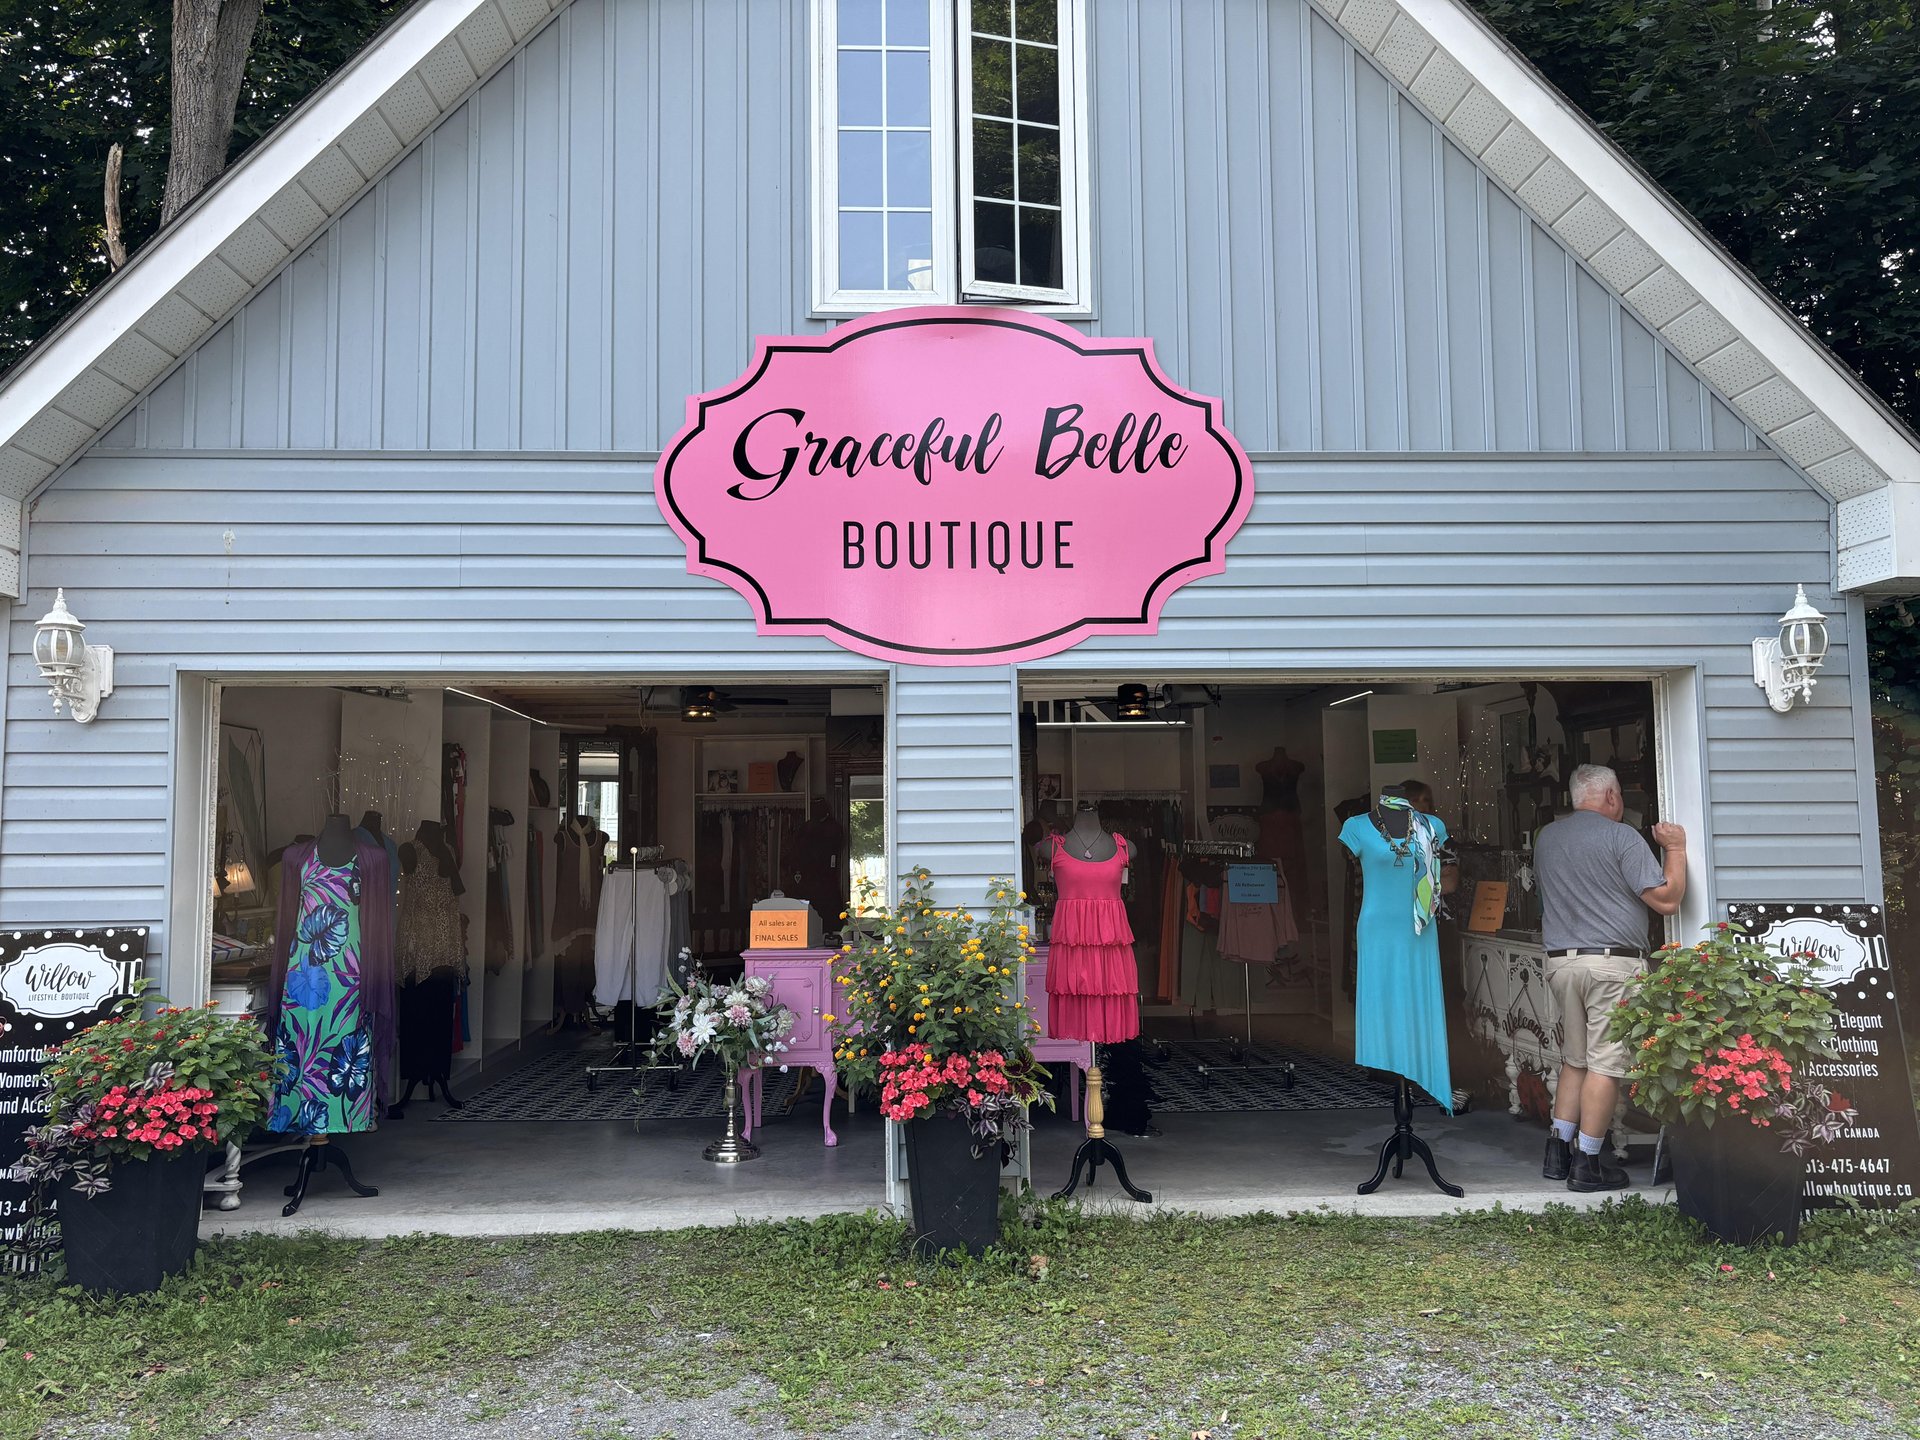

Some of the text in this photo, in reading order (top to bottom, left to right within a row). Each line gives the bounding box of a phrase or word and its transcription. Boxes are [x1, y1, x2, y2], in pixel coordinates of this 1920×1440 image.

[726, 403, 1189, 501] Graceful Belle
[842, 520, 1075, 575] BOUTIQUE
[755, 934, 799, 942] FINAL SALES
[25, 962, 97, 993] Willow
[28, 992, 90, 1002] LIFESTYLE BOUTIQUE
[1502, 1007, 1550, 1049] Welcome
[1838, 1011, 1884, 1032] Elegant
[1829, 1035, 1879, 1057] Clothing
[1808, 1060, 1879, 1078] Accessories
[1843, 1127, 1880, 1139] CANADA
